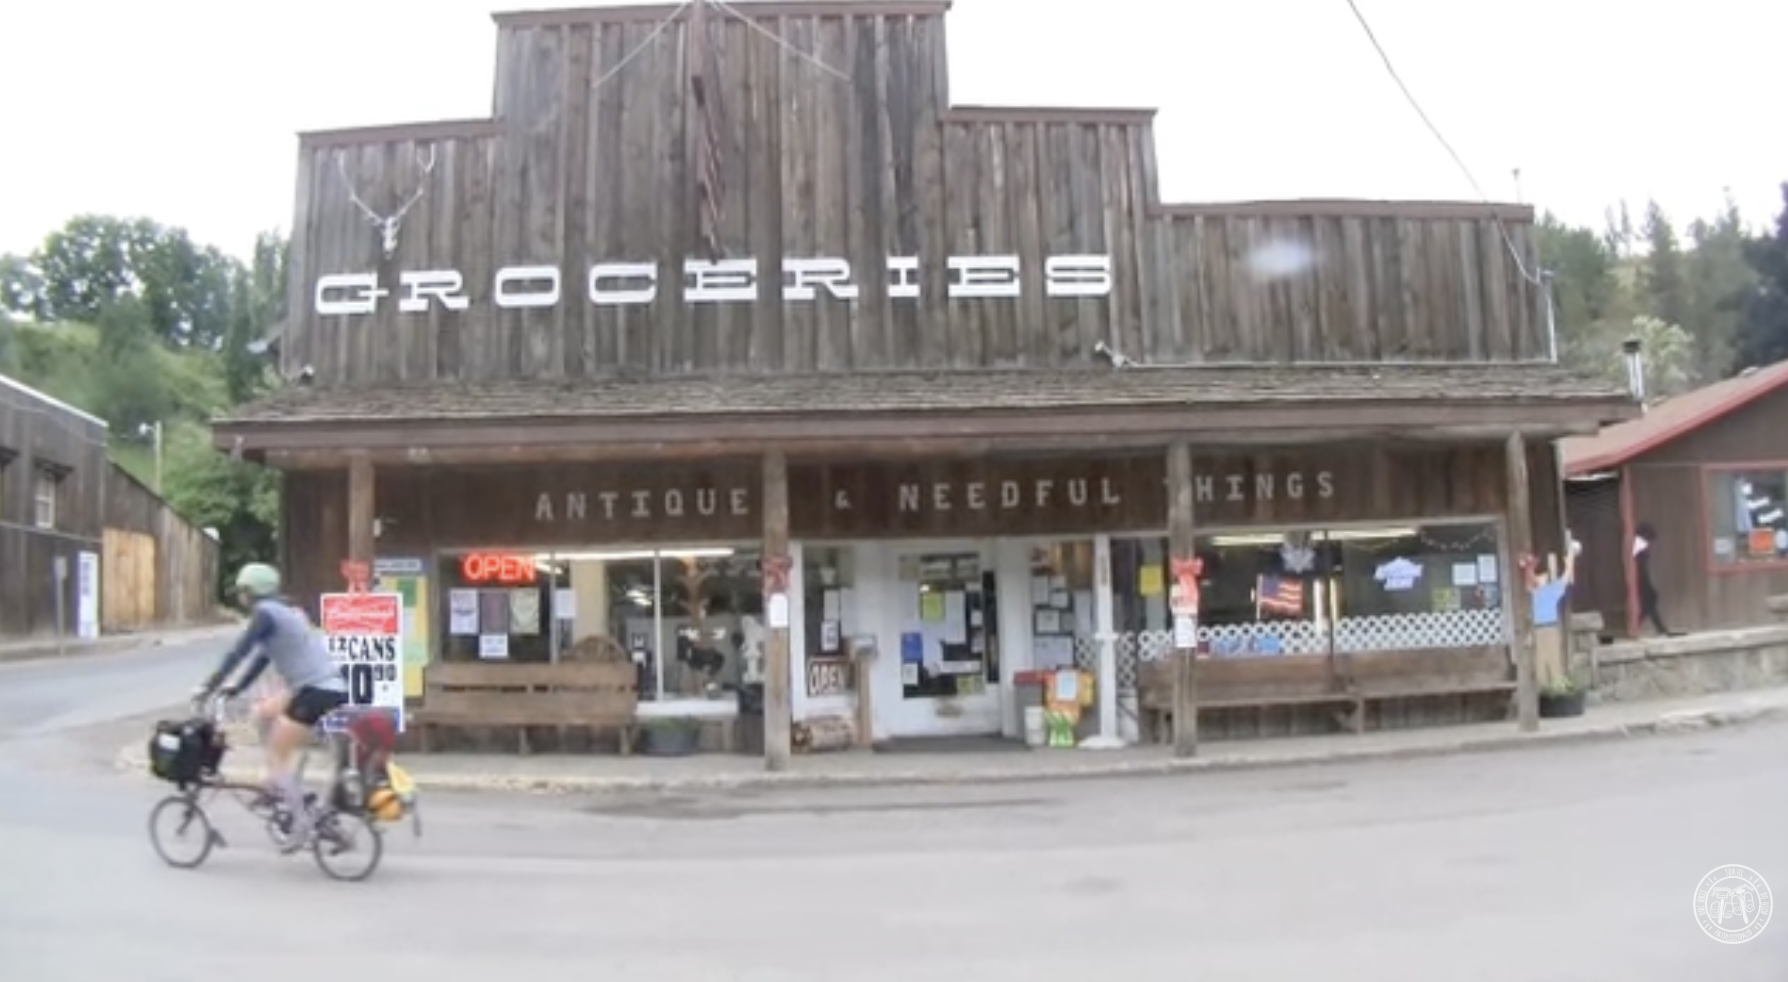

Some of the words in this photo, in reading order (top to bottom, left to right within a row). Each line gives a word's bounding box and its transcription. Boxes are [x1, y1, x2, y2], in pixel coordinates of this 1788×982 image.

[315, 253, 1113, 314] GROCERIES
[835, 490, 852, 510] &
[900, 479, 1120, 512] NEEDFUL
[1163, 471, 1335, 502] HINGS
[463, 552, 536, 582] OPEN
[349, 636, 395, 661] CANS
